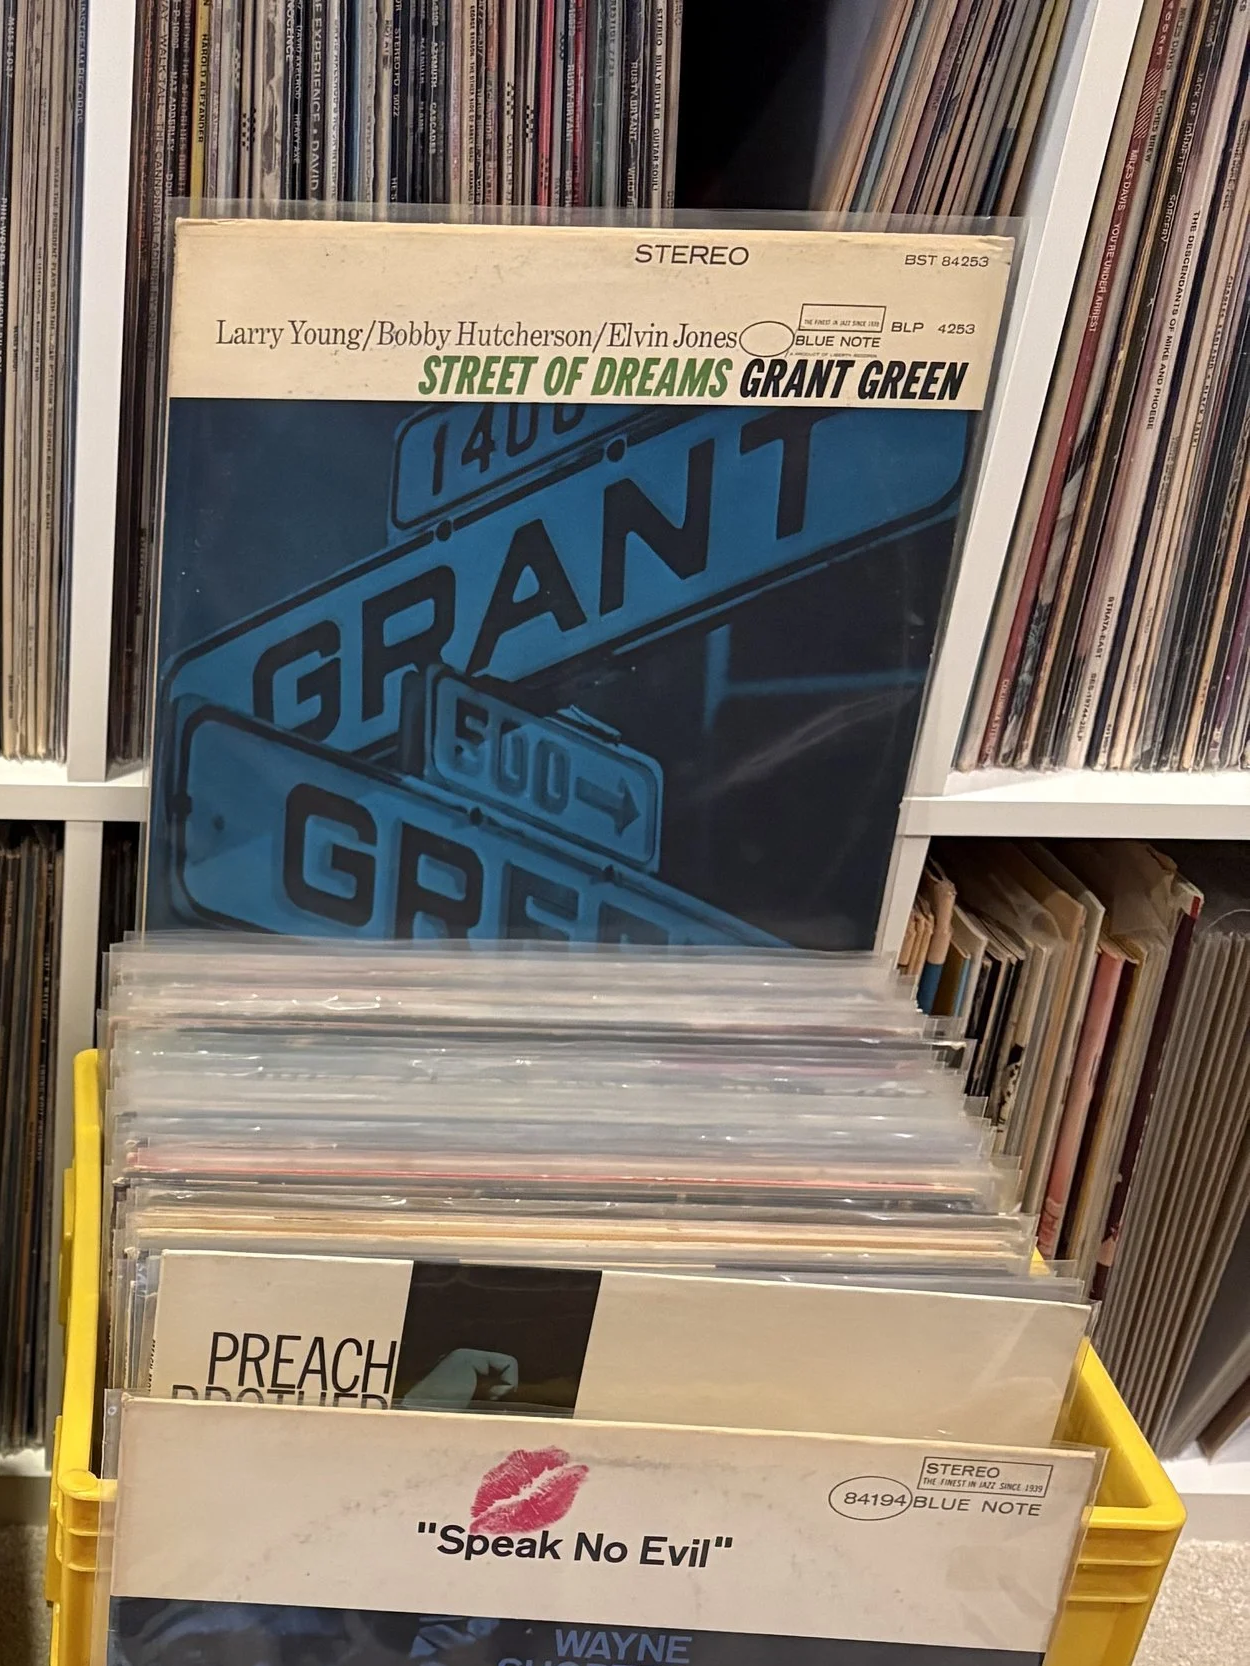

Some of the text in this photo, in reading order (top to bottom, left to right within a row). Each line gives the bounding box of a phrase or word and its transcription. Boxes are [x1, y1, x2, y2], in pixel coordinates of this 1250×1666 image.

[6, 16, 14, 46] MUSE
[197, 33, 208, 142] HAROLD ALEXANDER
[293, 56, 301, 99] AXELROD
[309, 17, 323, 190] EXPERIENCE DAVID
[428, 41, 438, 154] AZYMUTH CASCADES
[565, 64, 574, 142] RUSTY BRYANT
[651, 8, 663, 161] STEREO BILLY BUTLER GUITAR
[1143, 40, 1178, 163] DAVIS BITCHES BREW
[166, 71, 177, 151] NAT ADDERLEY
[626, 62, 638, 193] RUSTY BRYANT WILD
[1158, 70, 1205, 242] JACK JOHNETTE SORCERY
[634, 243, 750, 267] STEREO
[904, 254, 990, 268] BST 84253
[1087, 148, 1138, 332] MILES DAVIS YOU'RE UNDER ARREST
[215, 320, 738, 354] Larry Young/Bobby Hutcherson/Elvin Jones
[795, 335, 882, 349] BLUE NOTE
[891, 321, 976, 335] BLP 4253
[1145, 209, 1200, 430] THE DESCENDANTS OF MIKE AND PHOEBE
[418, 356, 970, 401] STREET OF DREAMS GRANT GREEN
[252, 413, 834, 743] GRANT
[1092, 595, 1117, 658] STRATA-EAST
[451, 696, 571, 817] 500
[207, 1331, 399, 1396] PREACH
[923, 1477, 1043, 1493] THE FINEST IN JAZZ SINCE 1939
[925, 1462, 1001, 1479] STEREO
[843, 1492, 1042, 1517] 84194 BLUE NOTE
[417, 1521, 733, 1568] "Speak No Evil"
[554, 1628, 693, 1665] WAYNE
